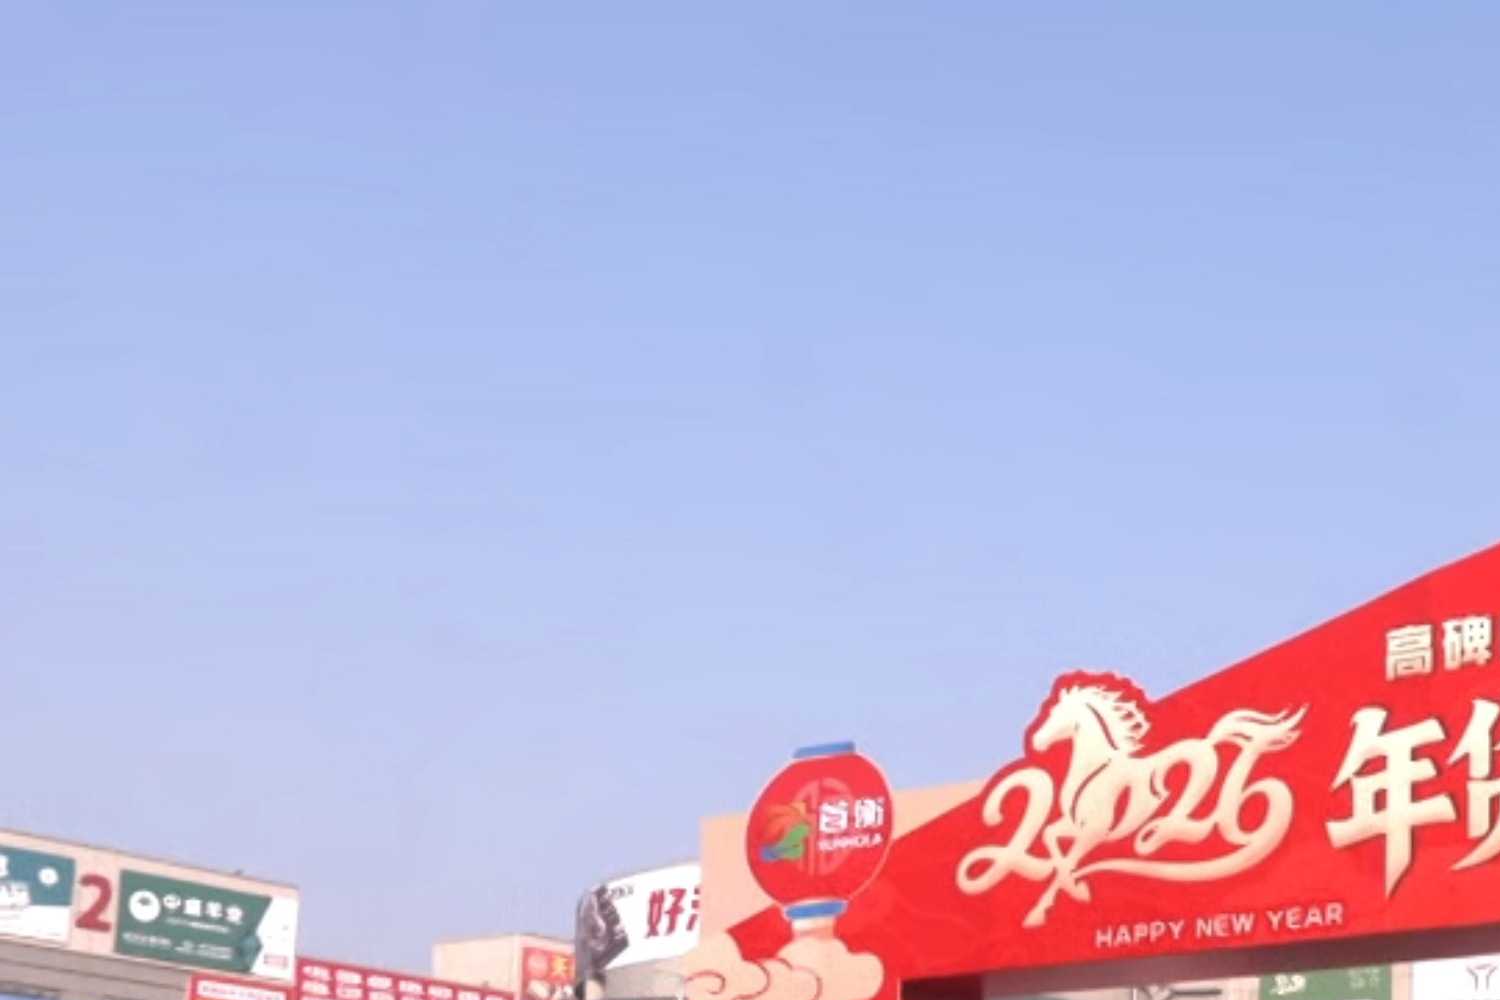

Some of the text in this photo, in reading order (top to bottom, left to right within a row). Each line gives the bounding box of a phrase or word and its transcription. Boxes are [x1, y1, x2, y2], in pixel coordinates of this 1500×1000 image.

[819, 797, 884, 834] 首衡
[954, 690, 1310, 928] 2026
[74, 874, 112, 933] 2
[1095, 902, 1344, 948] HAPPY NEW YEAR
